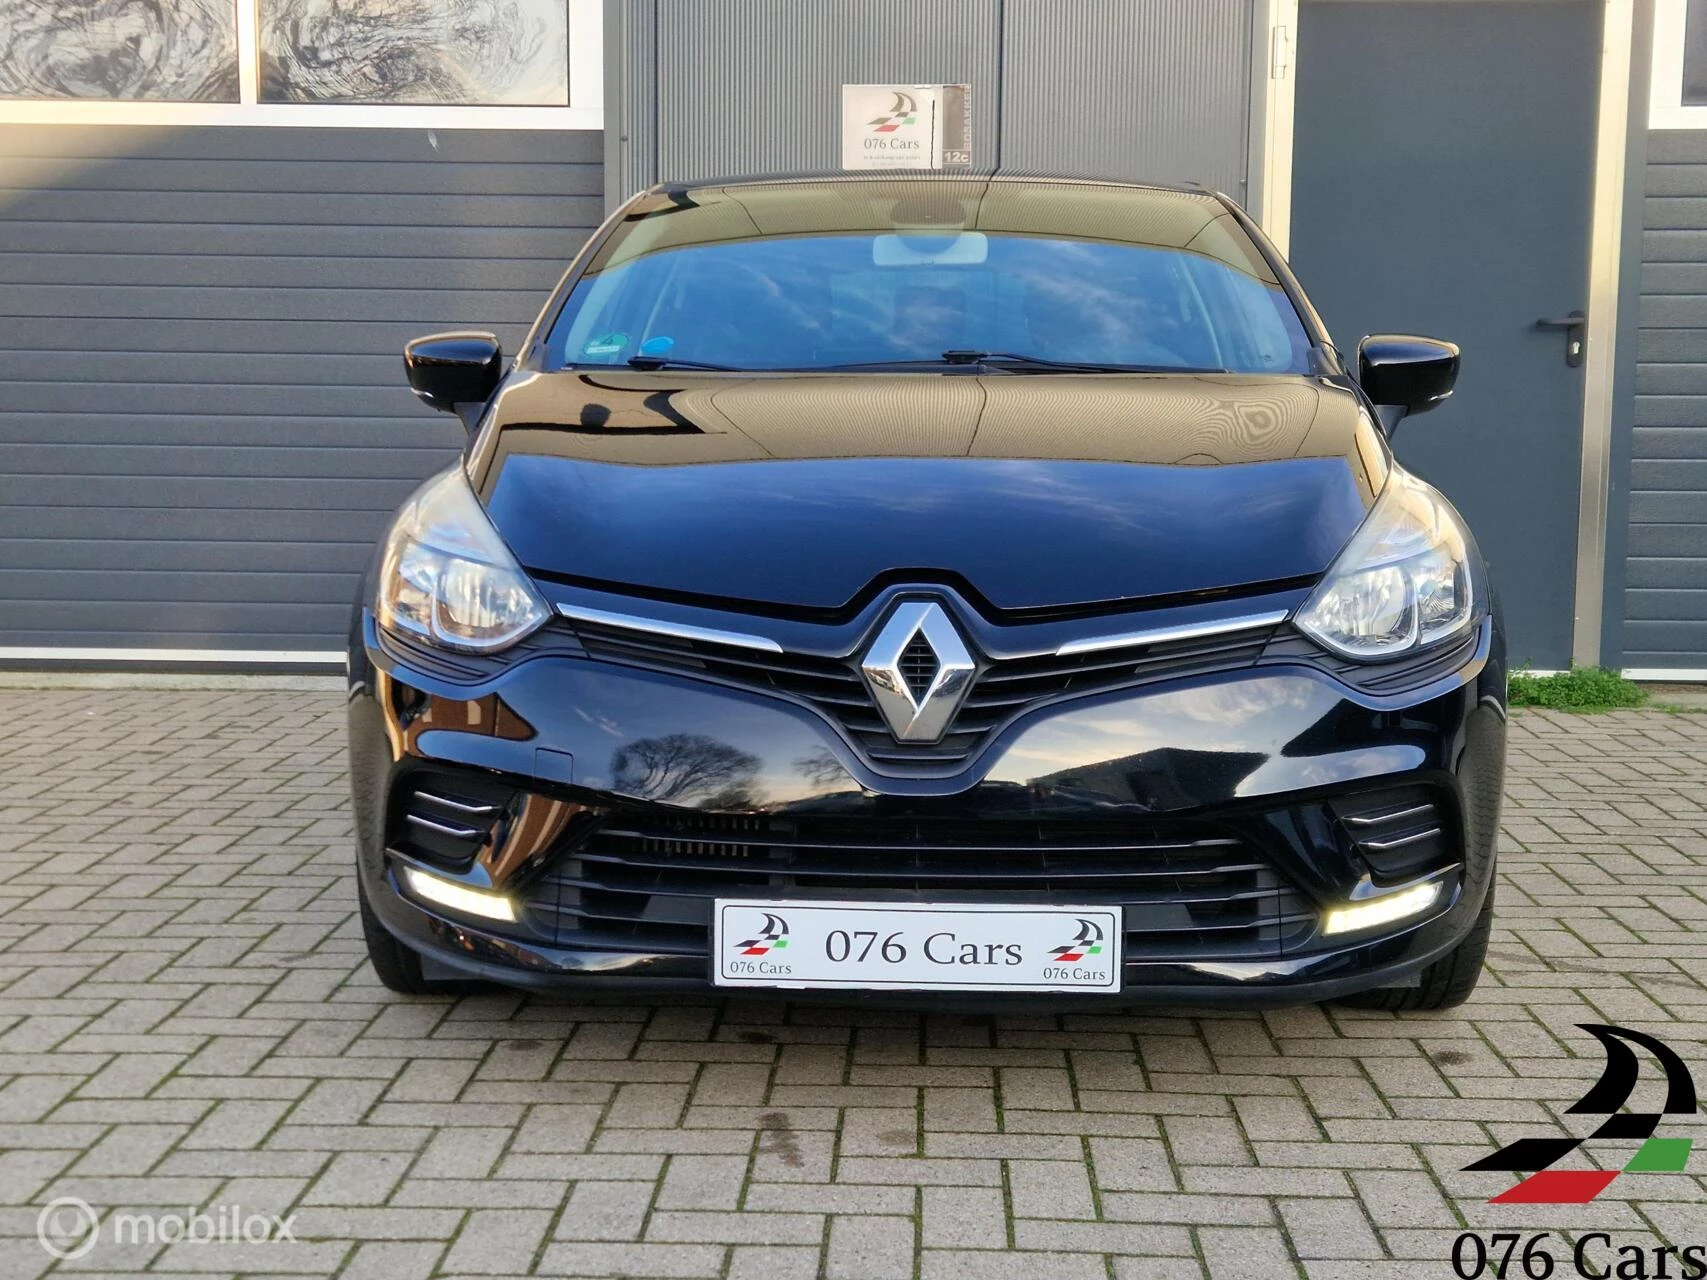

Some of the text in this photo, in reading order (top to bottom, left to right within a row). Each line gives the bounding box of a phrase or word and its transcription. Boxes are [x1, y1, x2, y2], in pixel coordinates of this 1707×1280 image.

[863, 138, 920, 150] 076 Cars
[944, 151, 969, 163] 12c
[825, 930, 1023, 965] 076 Cars
[730, 961, 792, 974] 076 Cars
[1043, 967, 1106, 980] 076 Cars
